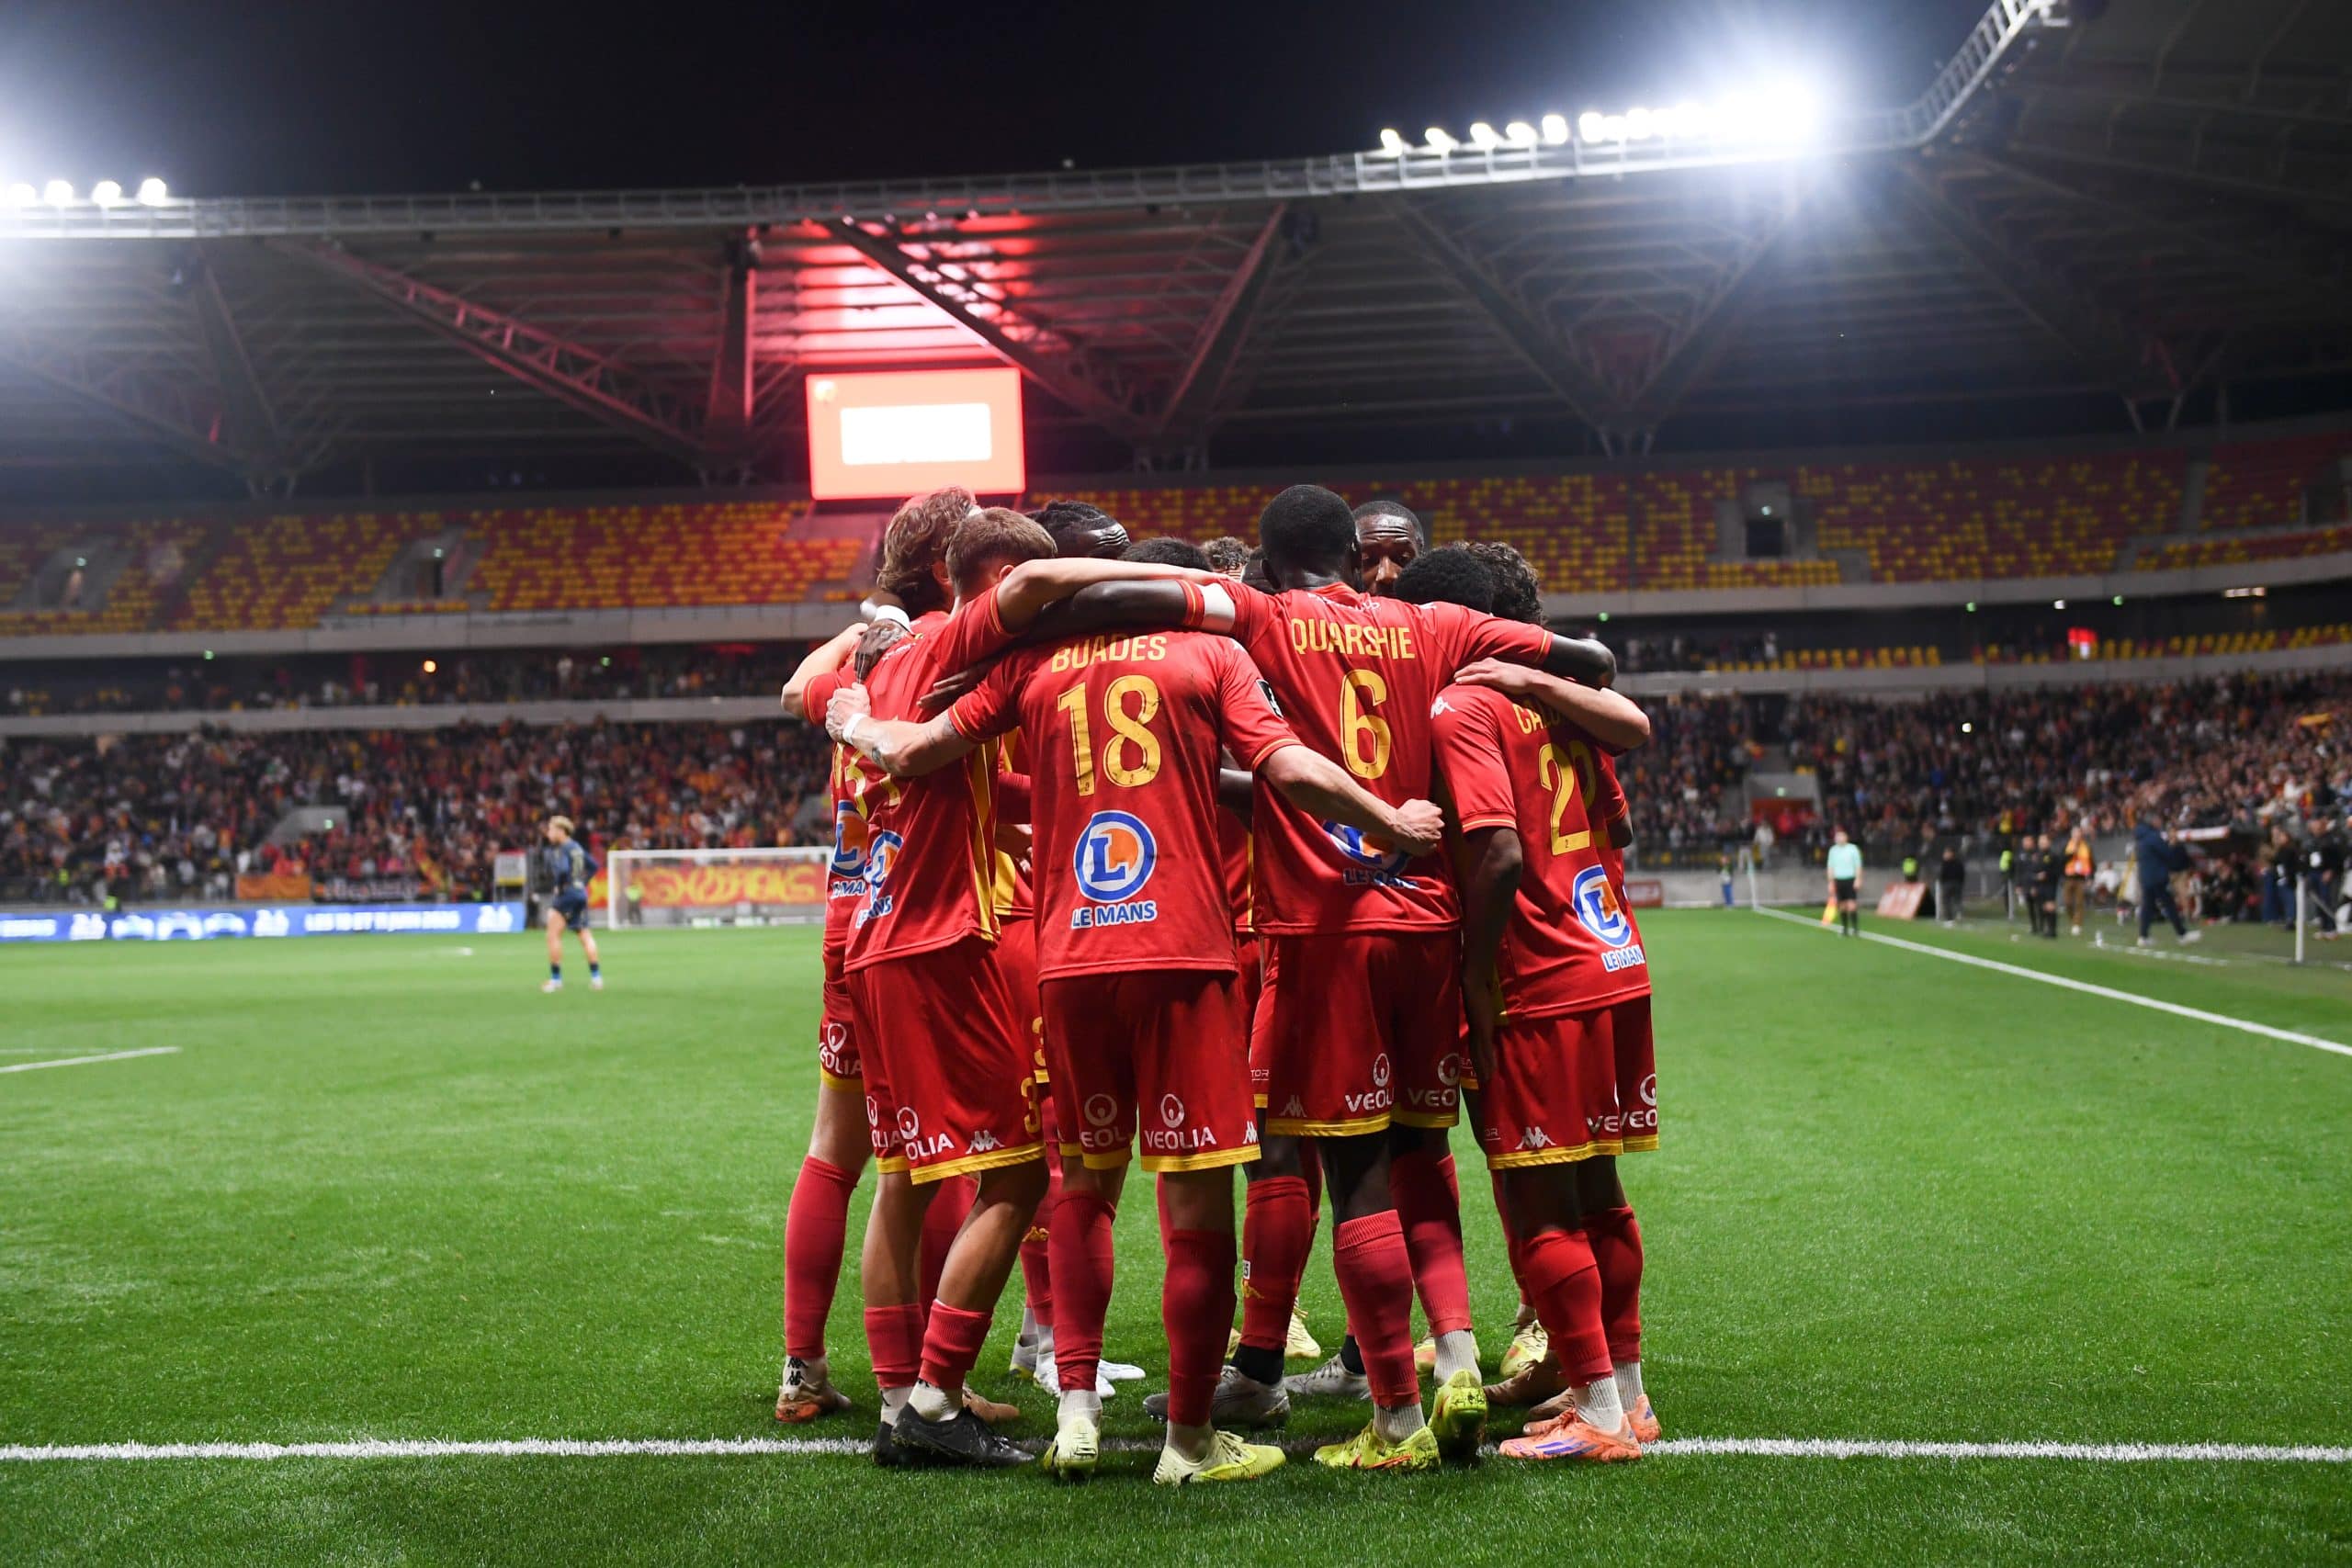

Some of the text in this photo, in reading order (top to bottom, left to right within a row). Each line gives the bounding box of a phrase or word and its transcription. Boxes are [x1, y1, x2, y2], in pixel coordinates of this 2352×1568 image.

[1051, 634, 1168, 673] BUADES
[1291, 618, 1416, 660] QUARSHIE
[1057, 674, 1161, 796] 18
[1340, 669, 1391, 780] 6
[1071, 902, 1156, 928] LE MANS
[1602, 945, 1645, 971] LE MAN
[905, 1133, 955, 1160] OLIA
[1144, 1126, 1217, 1149] VEOLIA
